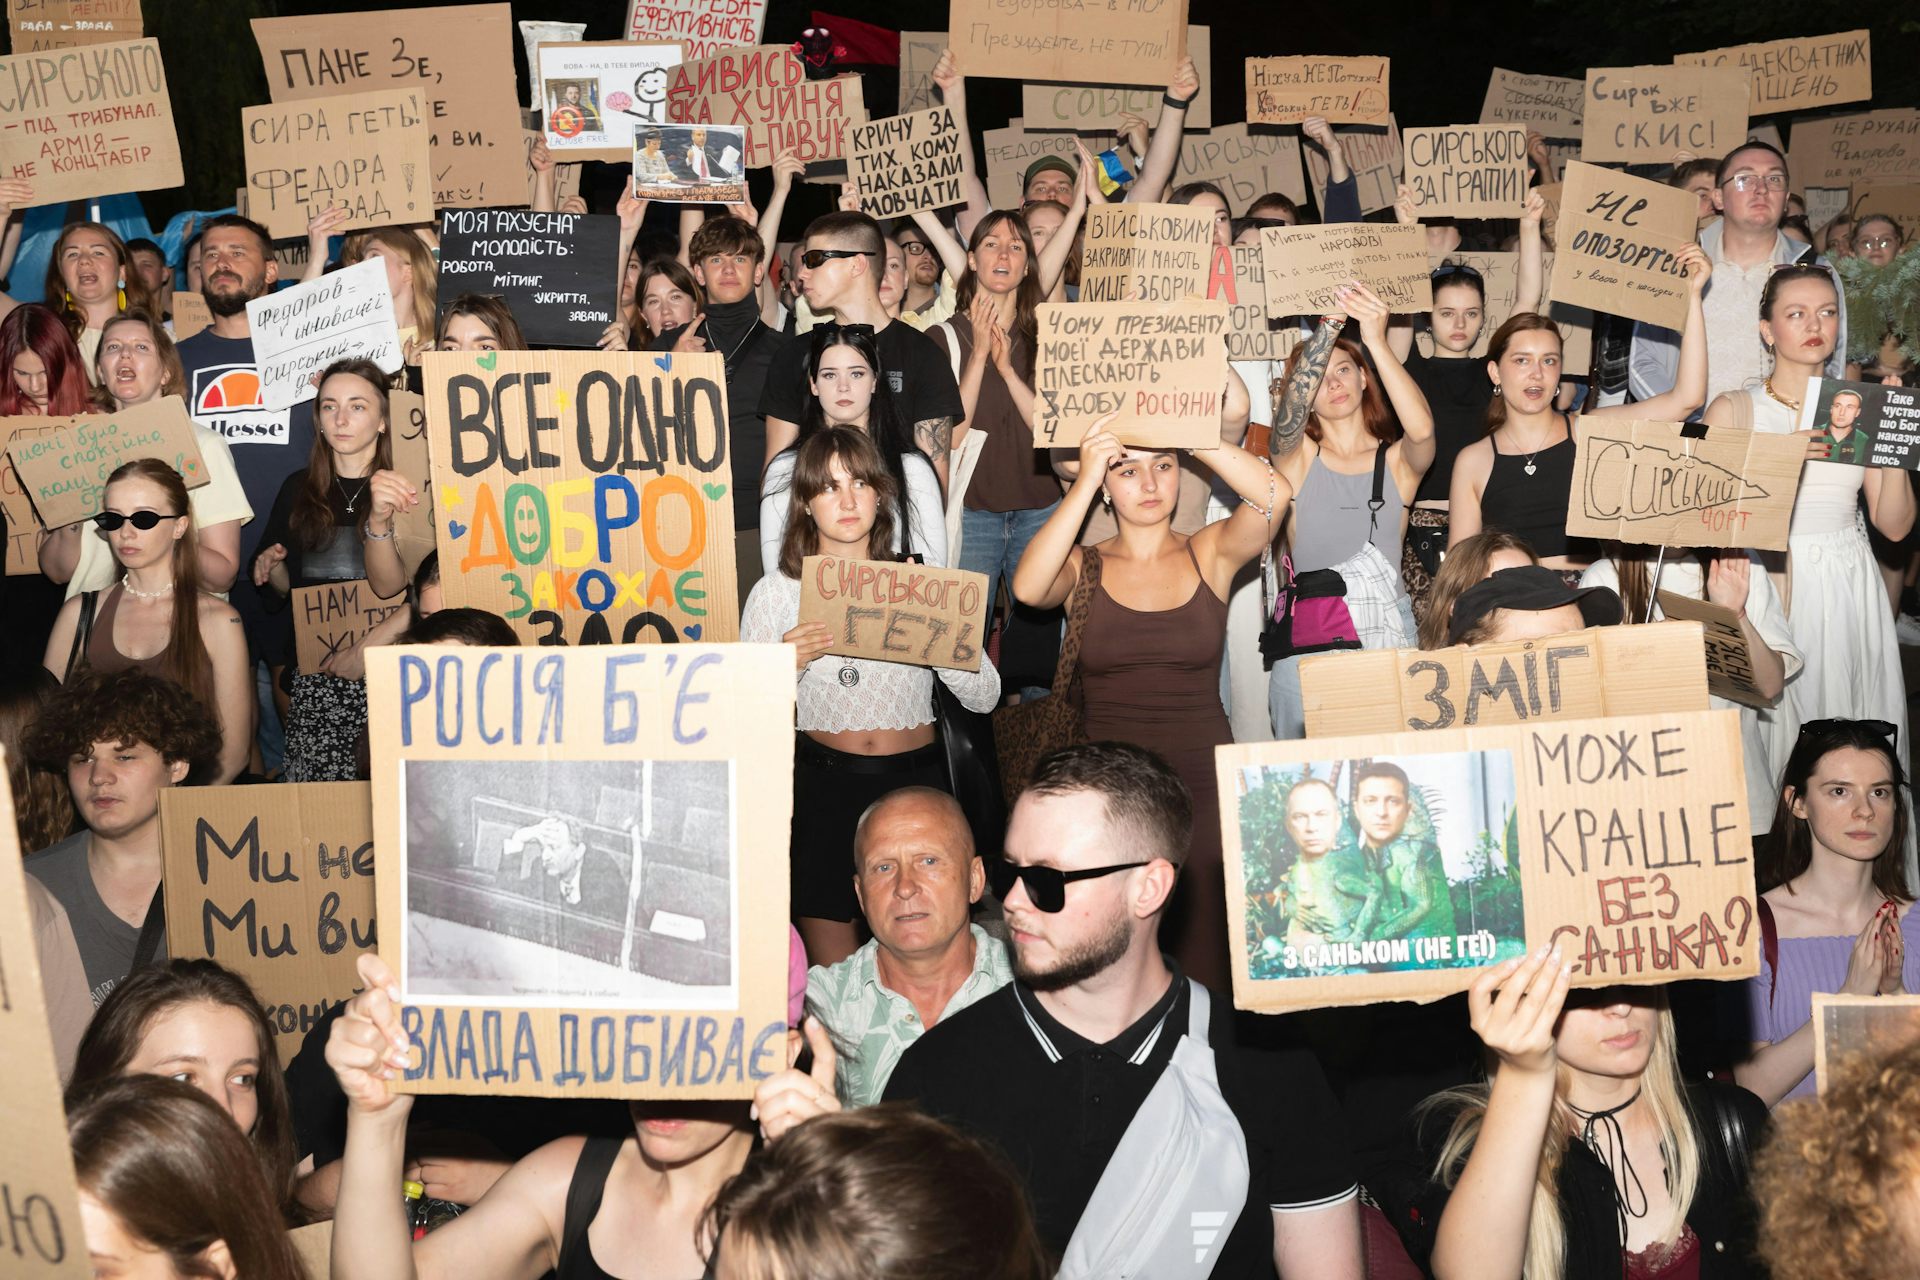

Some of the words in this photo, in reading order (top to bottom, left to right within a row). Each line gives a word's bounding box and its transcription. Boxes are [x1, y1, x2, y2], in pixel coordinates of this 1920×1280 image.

[1090, 38, 1113, 51] НЕ
[280, 48, 371, 88] ПАНЕ
[668, 51, 802, 101] ДИВИСЬ
[730, 82, 844, 126] ХУЙНЯ
[1544, 80, 1571, 94] ТУТ
[24, 116, 57, 135] ПІД
[68, 103, 162, 129] ТРИБУНАЛ.
[250, 108, 331, 145] СИРА
[348, 95, 421, 136] ГЕТЬ!
[852, 116, 913, 152] КРИЧУ
[929, 108, 956, 136] ЗА
[1493, 107, 1558, 122] ЦУКЕРКИ
[40, 133, 106, 159] АРМІЯ
[911, 133, 959, 161] КОМУ
[1411, 130, 1527, 167] СИРСЬКОГО
[1615, 120, 1715, 149] СКИС!
[12, 161, 37, 180] НЕ
[51, 145, 152, 173] КОНЦТАБІР
[857, 153, 963, 195] НАКАЗАЛИ
[251, 154, 386, 211] ФЕДОРА
[860, 178, 960, 217] МОВЧАТИ
[443, 211, 488, 235] МОЯ
[1091, 209, 1211, 244] ВІЙСЬКОВИМ
[1083, 247, 1147, 268] ЗАКРИВАТИ
[1152, 249, 1200, 270] МАЮТЬ
[1320, 235, 1383, 253] НАРОДОВІ
[442, 260, 496, 274] РОБОТА.
[1306, 260, 1346, 274] УСЬОМУ
[1352, 254, 1391, 265] СВІТОВІ
[534, 292, 591, 305] УКРИТТЯ.
[1083, 275, 1129, 302] ЛИШЕ
[1137, 275, 1195, 301] ЗБОРИ
[1271, 293, 1301, 305] КОЛИ
[568, 311, 612, 323] ЗАВАЛИ.
[1049, 311, 1104, 335] ЧОМУ
[1115, 315, 1225, 335] ПРЕЗИДЕНТУ
[1044, 338, 1089, 363] МОЄЇ
[1099, 337, 1205, 363] ДЕРЖАВИ
[1043, 361, 1161, 391] ПЛЕСКАЮТЬ
[1136, 386, 1216, 418] РОСІЯНИ
[1886, 390, 1914, 406] Таке
[447, 372, 560, 477] ВСЕ
[576, 370, 726, 476] ОДНО
[1879, 419, 1897, 429] шо
[1899, 418, 1919, 431] Бог
[17, 437, 65, 466] мені
[77, 424, 118, 451] було
[1871, 454, 1900, 466] шось
[1874, 443, 1894, 453] нас
[1896, 446, 1909, 455] за
[460, 474, 707, 574] ДОБРО
[1701, 508, 1752, 532] ЧОРТ
[501, 568, 708, 619] ЗАКОХАЄ
[817, 557, 980, 616] СИРСЬКОГО
[304, 584, 359, 625] НАМ
[844, 603, 977, 664] ГЕТЬ
[399, 652, 566, 747] РОСІЯ
[603, 652, 725, 746] Б'Є
[1532, 727, 1689, 788] МОЖЕ
[195, 815, 300, 885] Ми
[1539, 802, 1748, 877] КРАЩЕ
[1597, 872, 1681, 927] БЕЗ
[202, 898, 299, 958] Ми
[1549, 895, 1753, 976] САНЬКА?
[1283, 945, 1298, 969] З
[1303, 939, 1410, 968] САНЬКОМ
[1415, 935, 1452, 964] (НЕ
[1457, 929, 1497, 960] ГЕЇ)
[401, 1005, 544, 1083] ВЛАДА
[553, 1014, 787, 1088] ДОБИВАЄ
